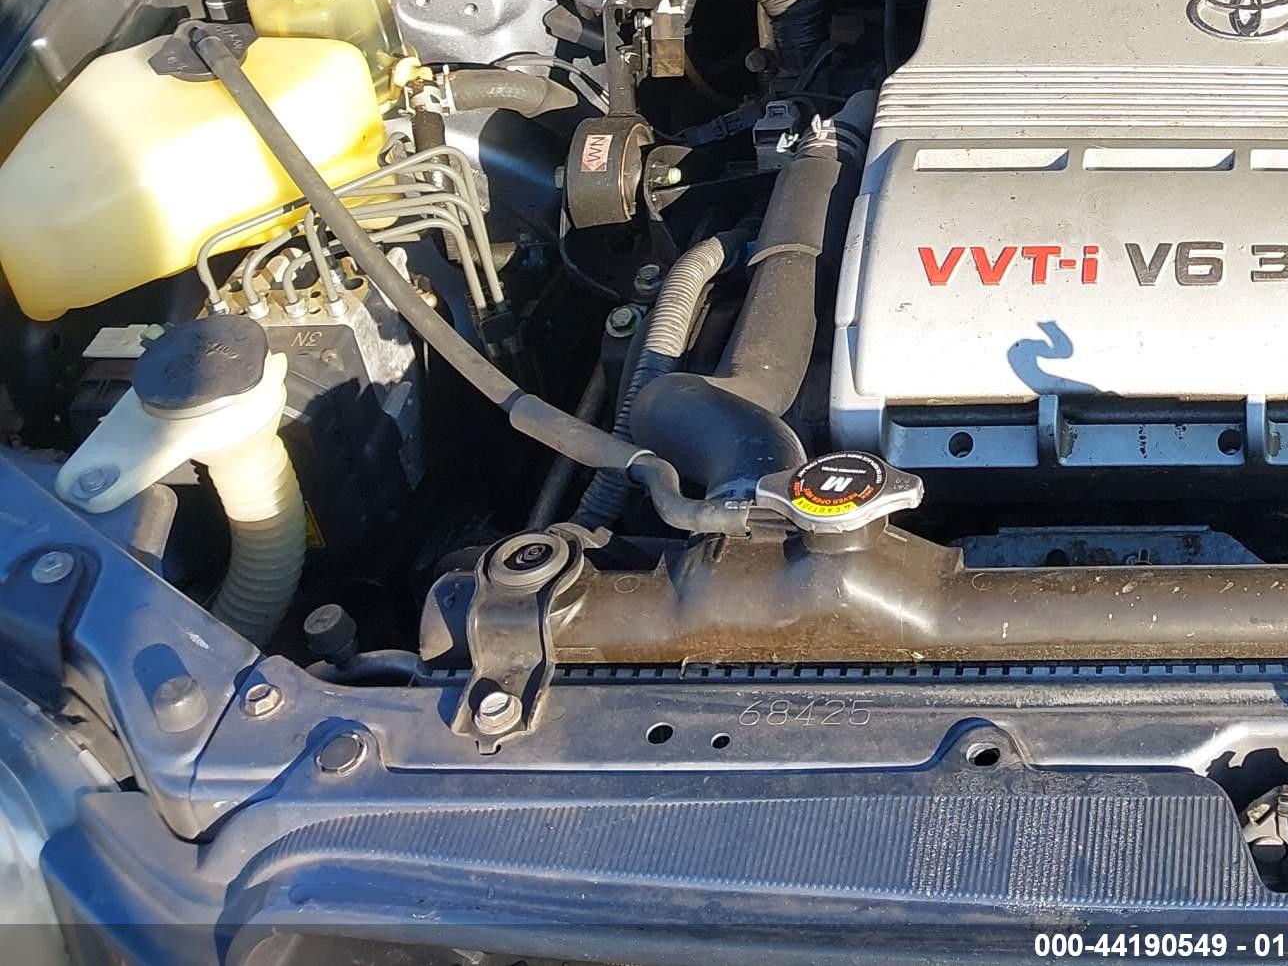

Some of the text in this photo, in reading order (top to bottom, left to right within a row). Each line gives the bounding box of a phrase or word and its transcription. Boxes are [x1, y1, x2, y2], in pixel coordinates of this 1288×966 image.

[917, 243, 1100, 286] VVT-i
[1124, 241, 1225, 286] V6
[798, 500, 841, 513] CAUTION
[738, 699, 875, 726] 68425
